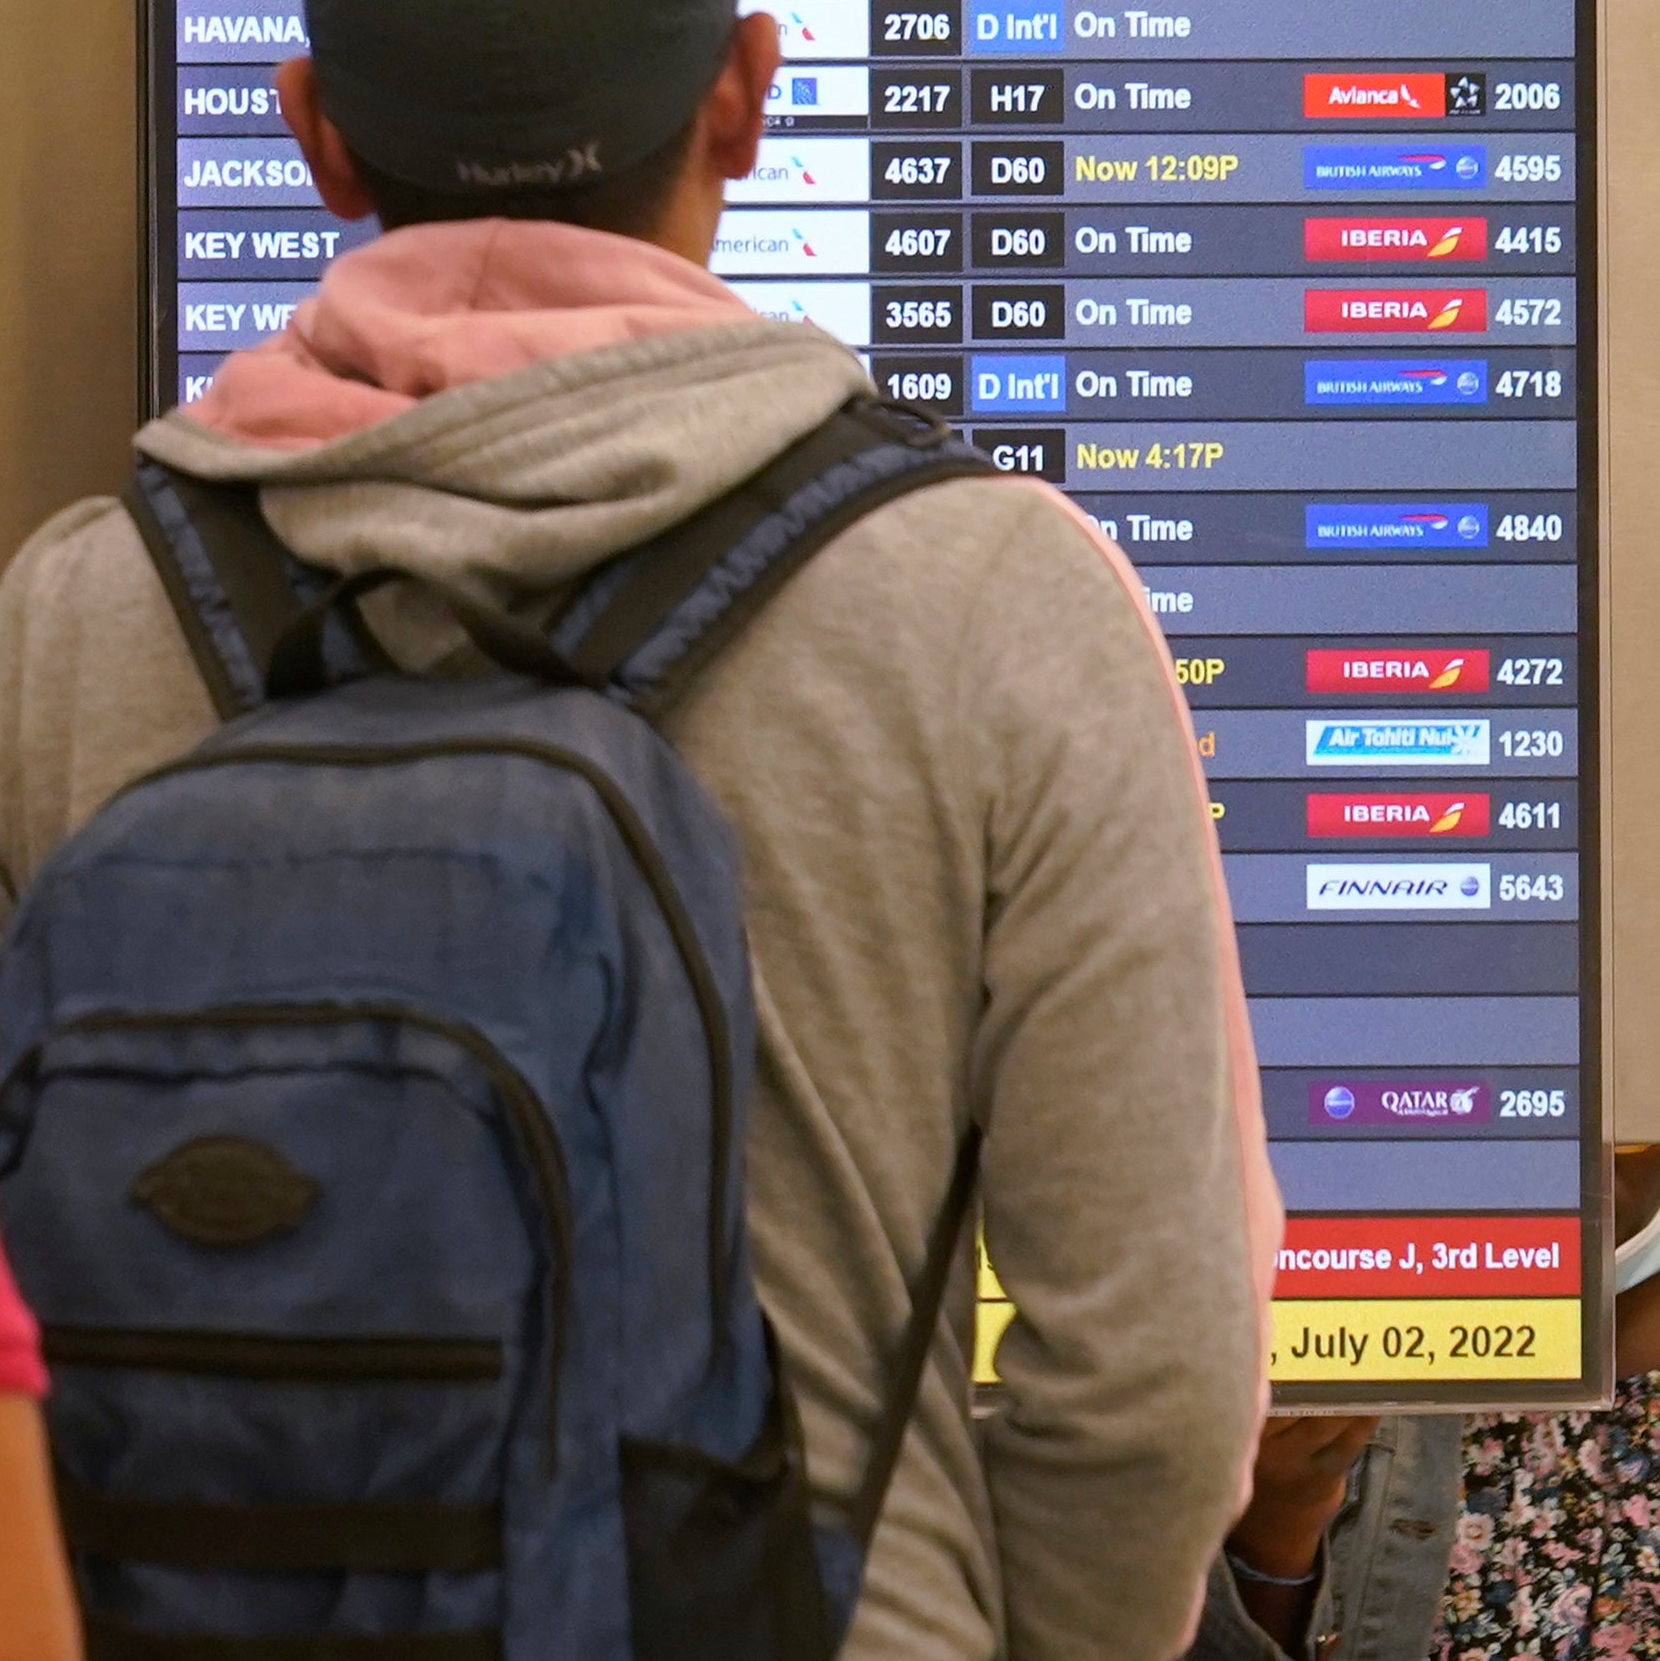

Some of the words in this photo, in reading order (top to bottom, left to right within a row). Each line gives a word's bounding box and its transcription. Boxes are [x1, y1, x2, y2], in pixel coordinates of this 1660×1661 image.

[991, 85, 1044, 111] H17
[1076, 156, 1137, 181] Now
[1145, 155, 1238, 180] 12:09P
[1495, 155, 1561, 181] 4595
[186, 232, 245, 258] KEY
[252, 232, 339, 258] WEST
[1499, 731, 1562, 756] 1230
[1319, 880, 1447, 895] FINNAIR
[1500, 875, 1563, 900] 5643
[1399, 1243, 1423, 1274] J,
[1432, 1243, 1477, 1269] 3rd
[1486, 1243, 1559, 1268] Level
[1292, 1327, 1368, 1366] July
[1383, 1327, 1434, 1365] 02,
[1450, 1326, 1535, 1357] 2022
